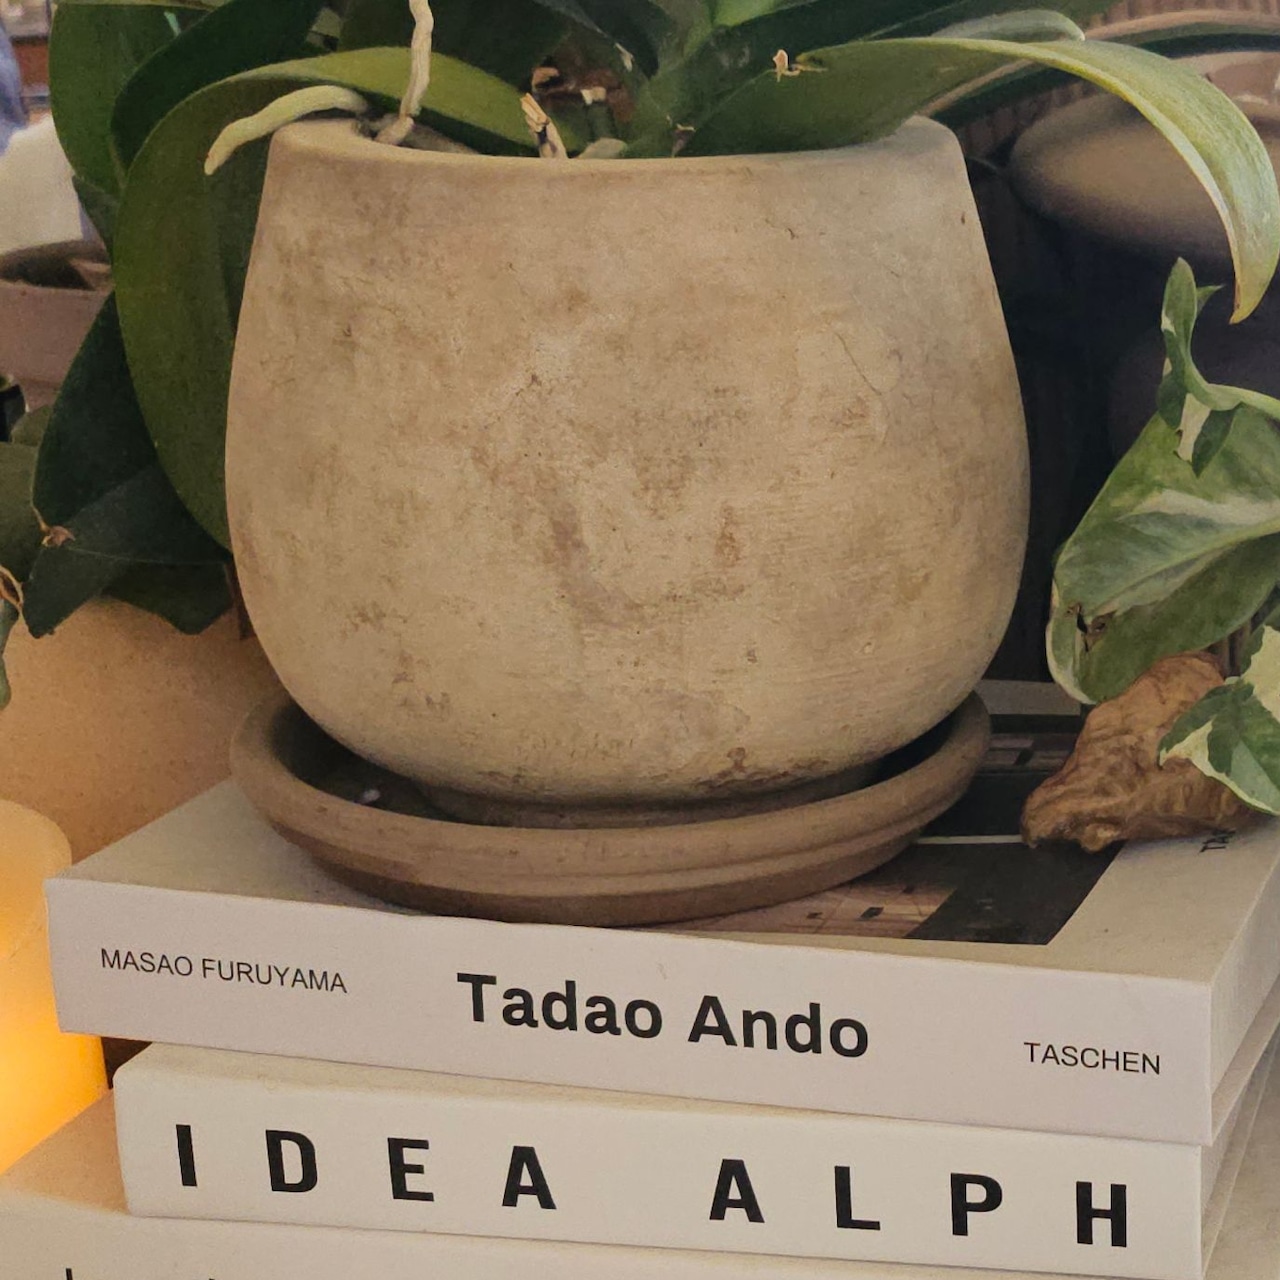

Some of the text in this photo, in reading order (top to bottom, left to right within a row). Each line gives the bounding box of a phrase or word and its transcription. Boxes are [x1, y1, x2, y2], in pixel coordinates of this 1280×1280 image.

[101, 948, 348, 994] MASAO FURUYAMA
[456, 972, 869, 1058] Tadao Ando
[1023, 1042, 1160, 1075] TASCHEN
[175, 1123, 1128, 1248] IDEA ALPH
